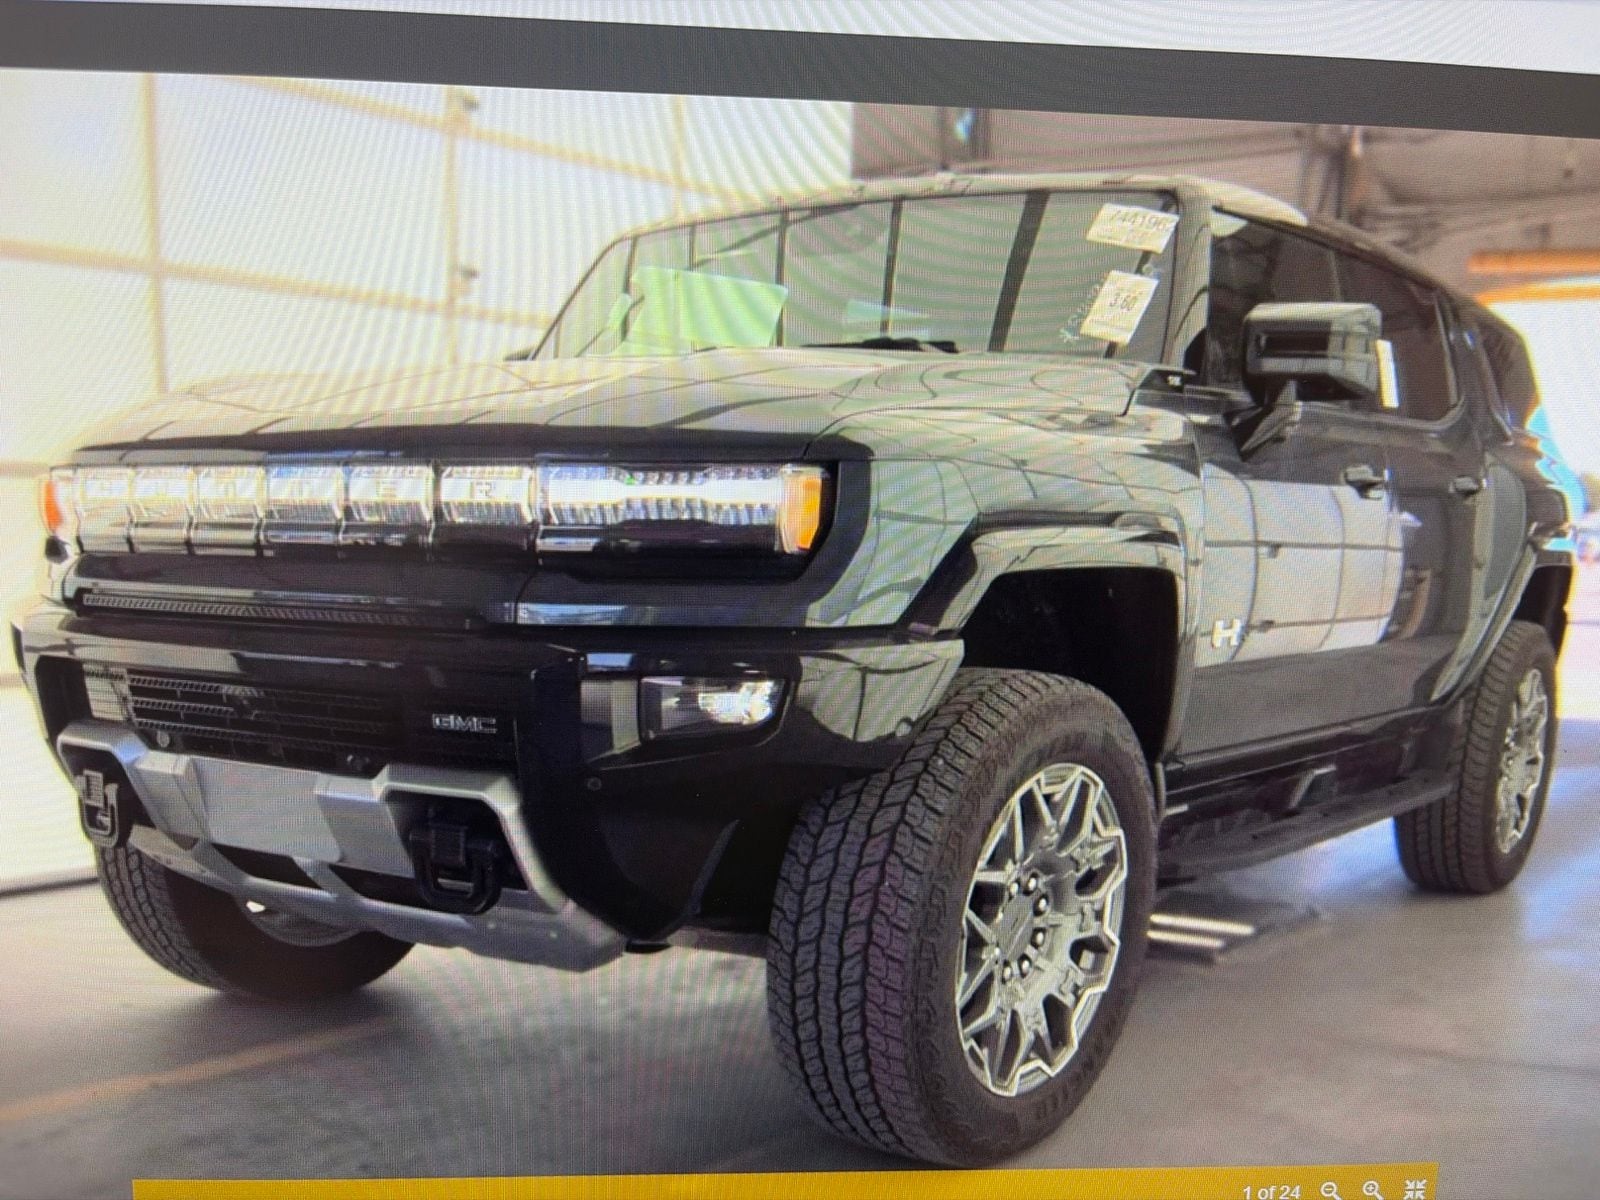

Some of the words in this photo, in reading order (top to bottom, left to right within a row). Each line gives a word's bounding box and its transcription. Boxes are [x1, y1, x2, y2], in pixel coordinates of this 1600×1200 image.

[1213, 618, 1243, 648] H
[431, 713, 497, 734] GMC
[1243, 1185, 1251, 1200] 1
[1257, 1185, 1277, 1200] of
[1279, 1184, 1301, 1200] 24
